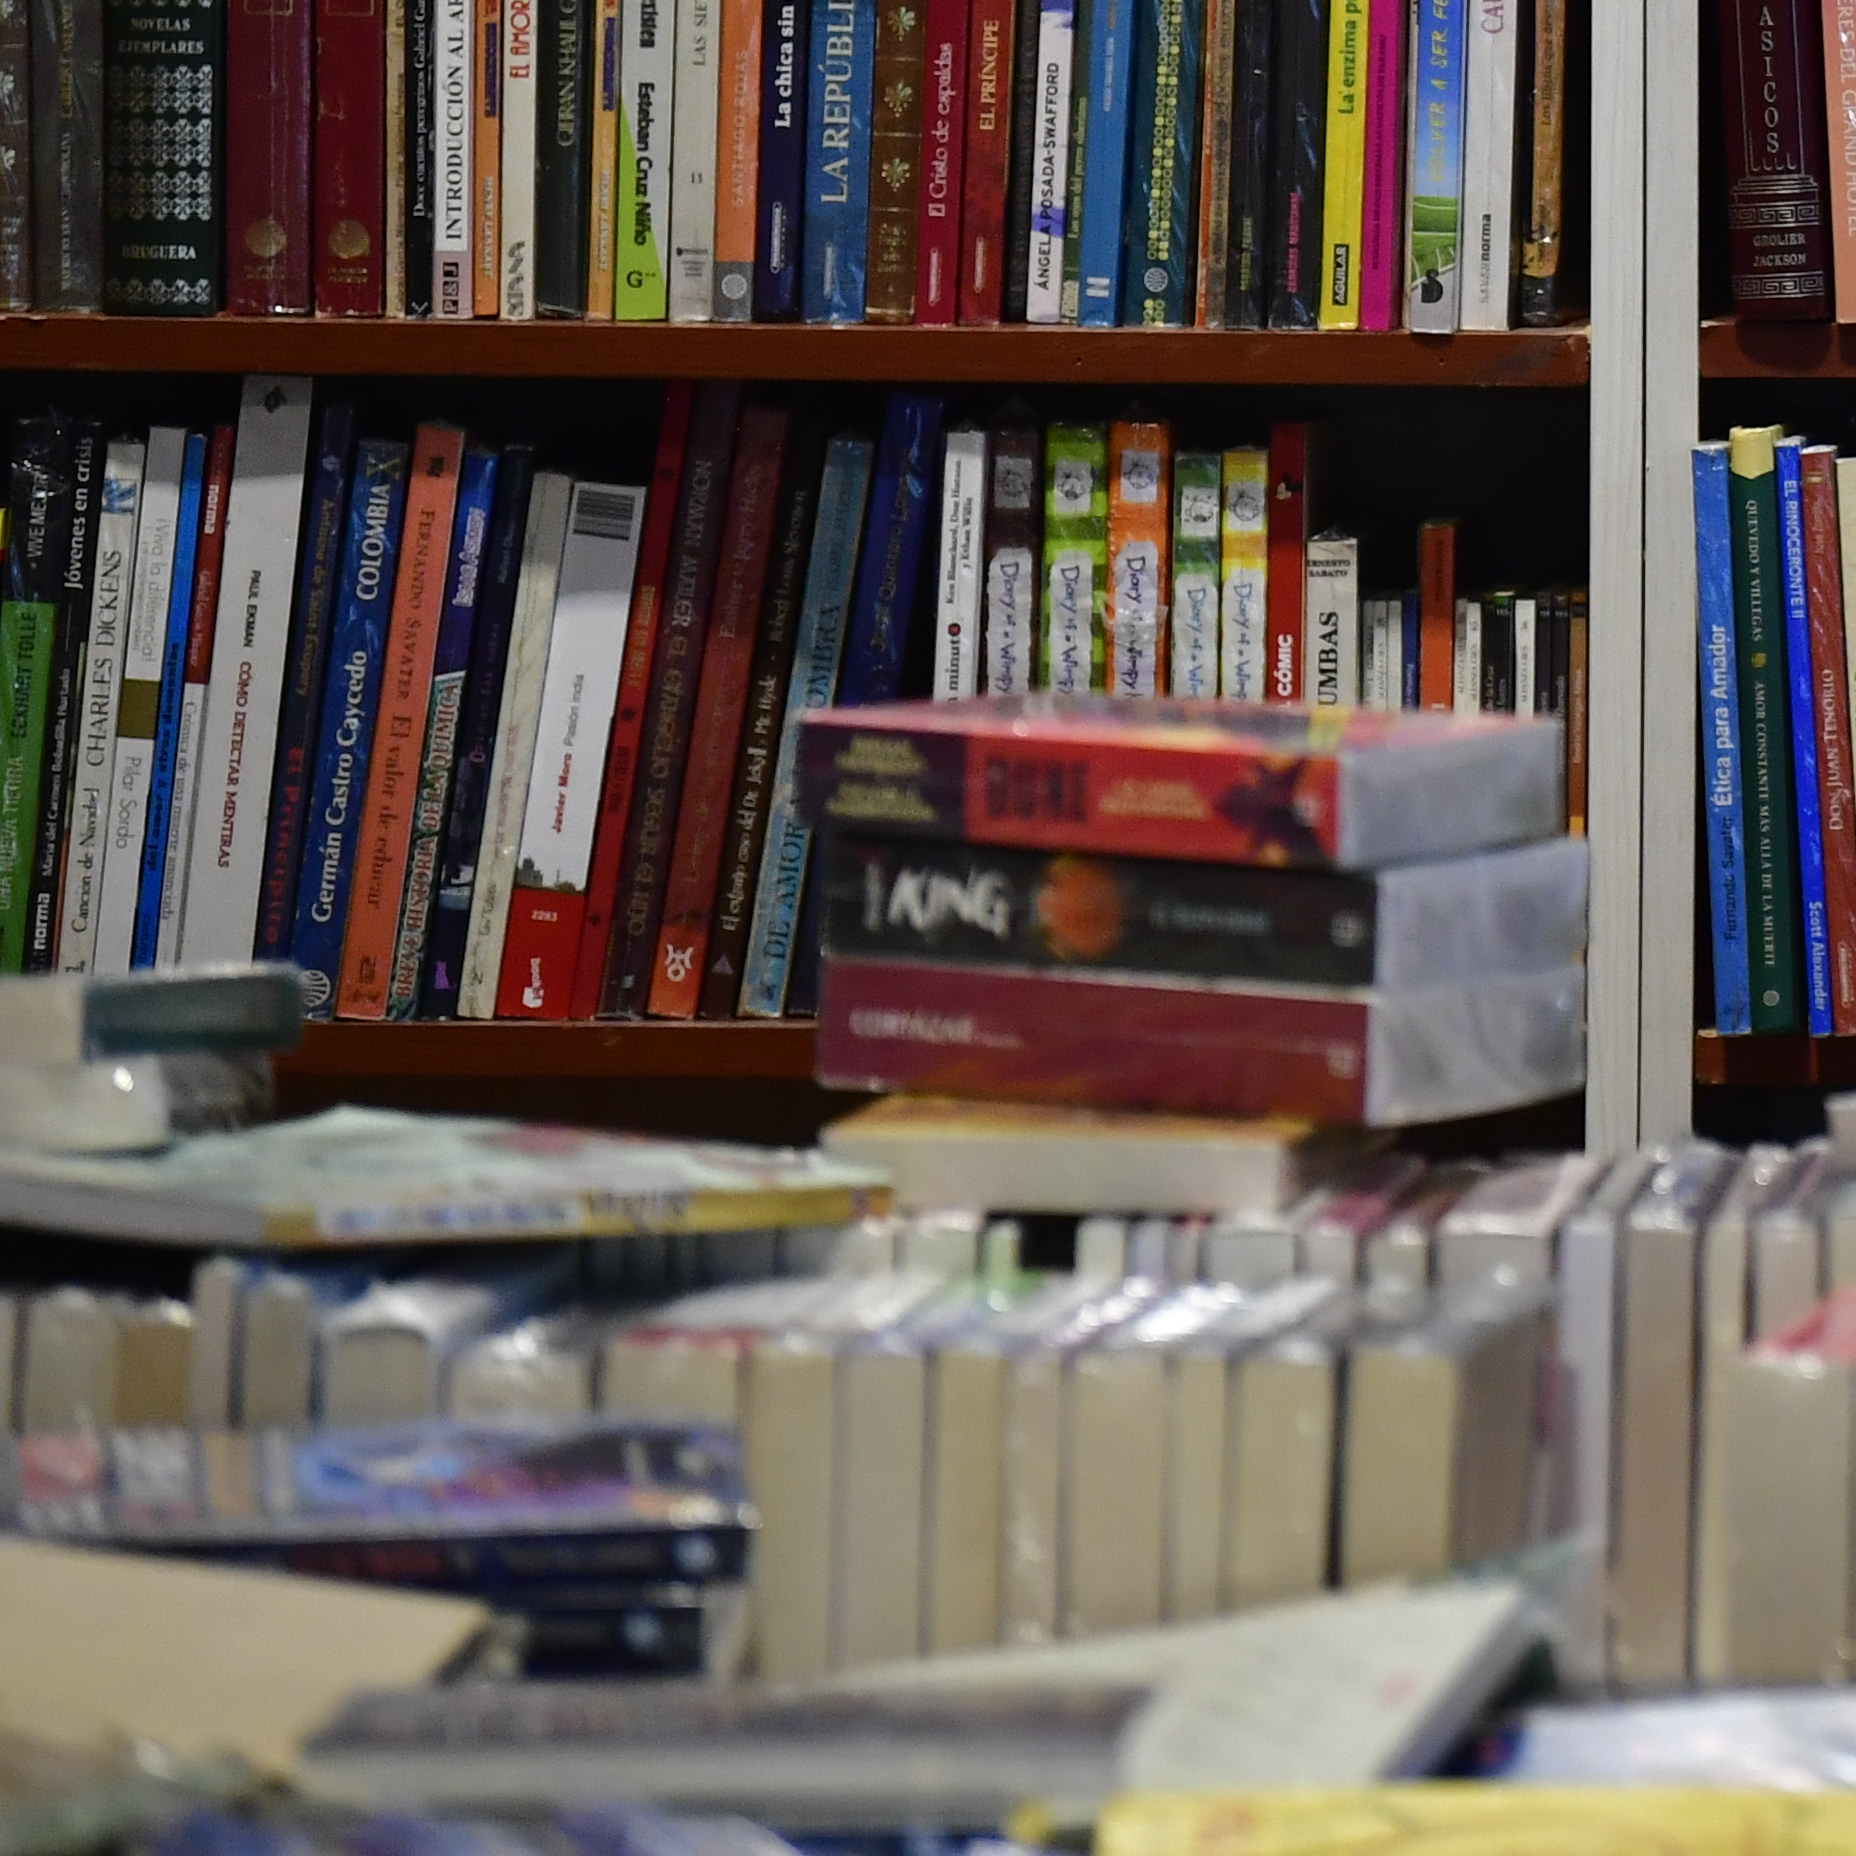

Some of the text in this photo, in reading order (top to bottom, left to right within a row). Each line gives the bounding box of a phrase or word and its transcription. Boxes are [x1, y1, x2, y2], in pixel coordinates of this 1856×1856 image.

[447, 28, 464, 58] AL
[775, 41, 794, 97] chica
[778, 5, 795, 36] sin
[442, 63, 465, 241] INTRODUCCIÓN
[775, 101, 794, 128] La
[822, 158, 849, 203] LA
[62, 437, 94, 589] Jóvenes en crisis
[85, 550, 122, 766] CHARLES DICKENS
[311, 484, 392, 923] Germán Castro Caycedo COLOMBIA
[1709, 625, 1734, 807] Ética para Amador
